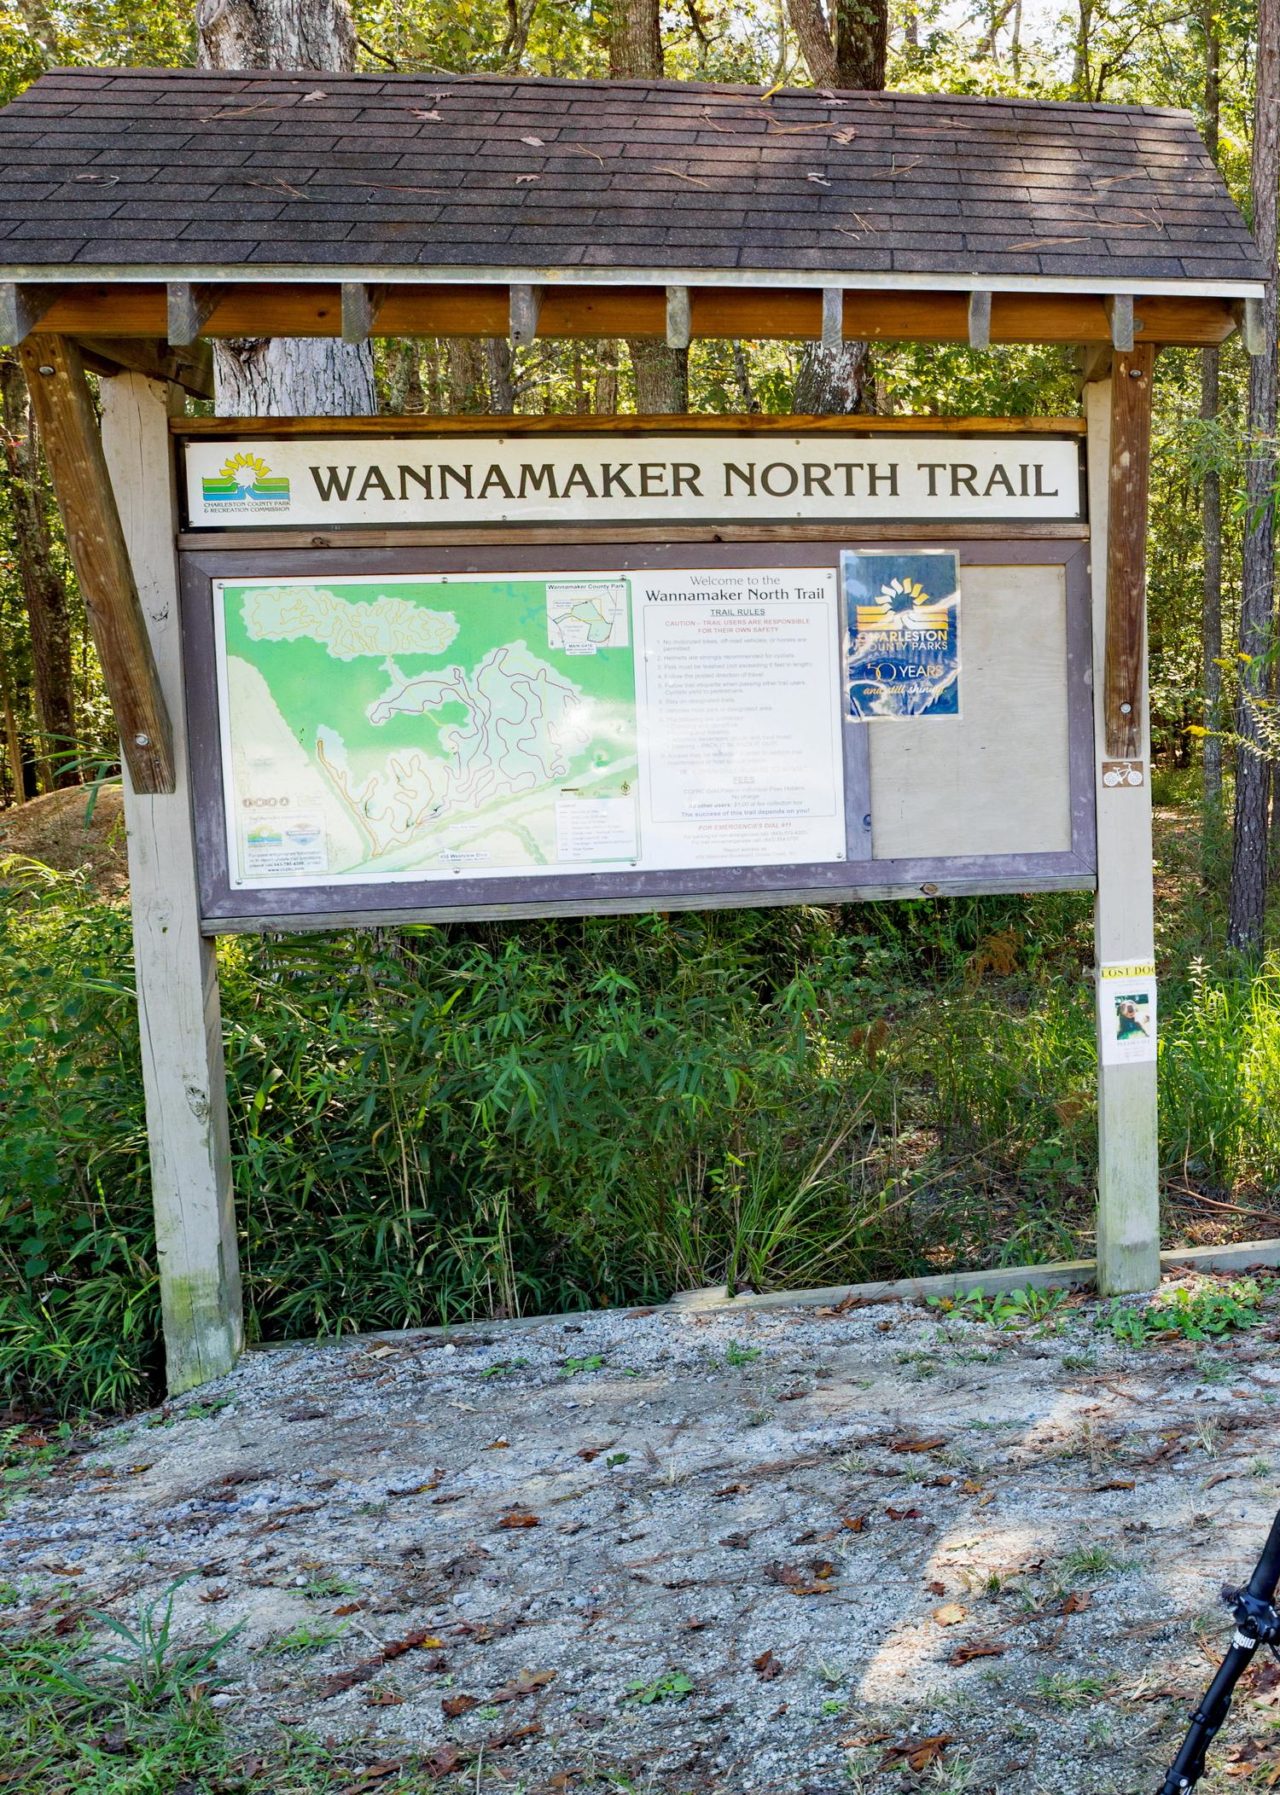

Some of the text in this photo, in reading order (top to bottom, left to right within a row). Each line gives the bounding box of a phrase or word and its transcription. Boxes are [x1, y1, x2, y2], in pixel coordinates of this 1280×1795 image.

[308, 462, 1058, 502] WANNAMAKER NORTH TRAIL
[689, 575, 781, 586] Welcome to the
[645, 587, 825, 602] Wannamaker North Trail
[710, 608, 766, 617] TRAIL RULES
[764, 617, 810, 625] RESPONSIBLE
[753, 625, 779, 633] SAFETY
[911, 640, 948, 650] PARKS
[899, 665, 945, 678] YEARS
